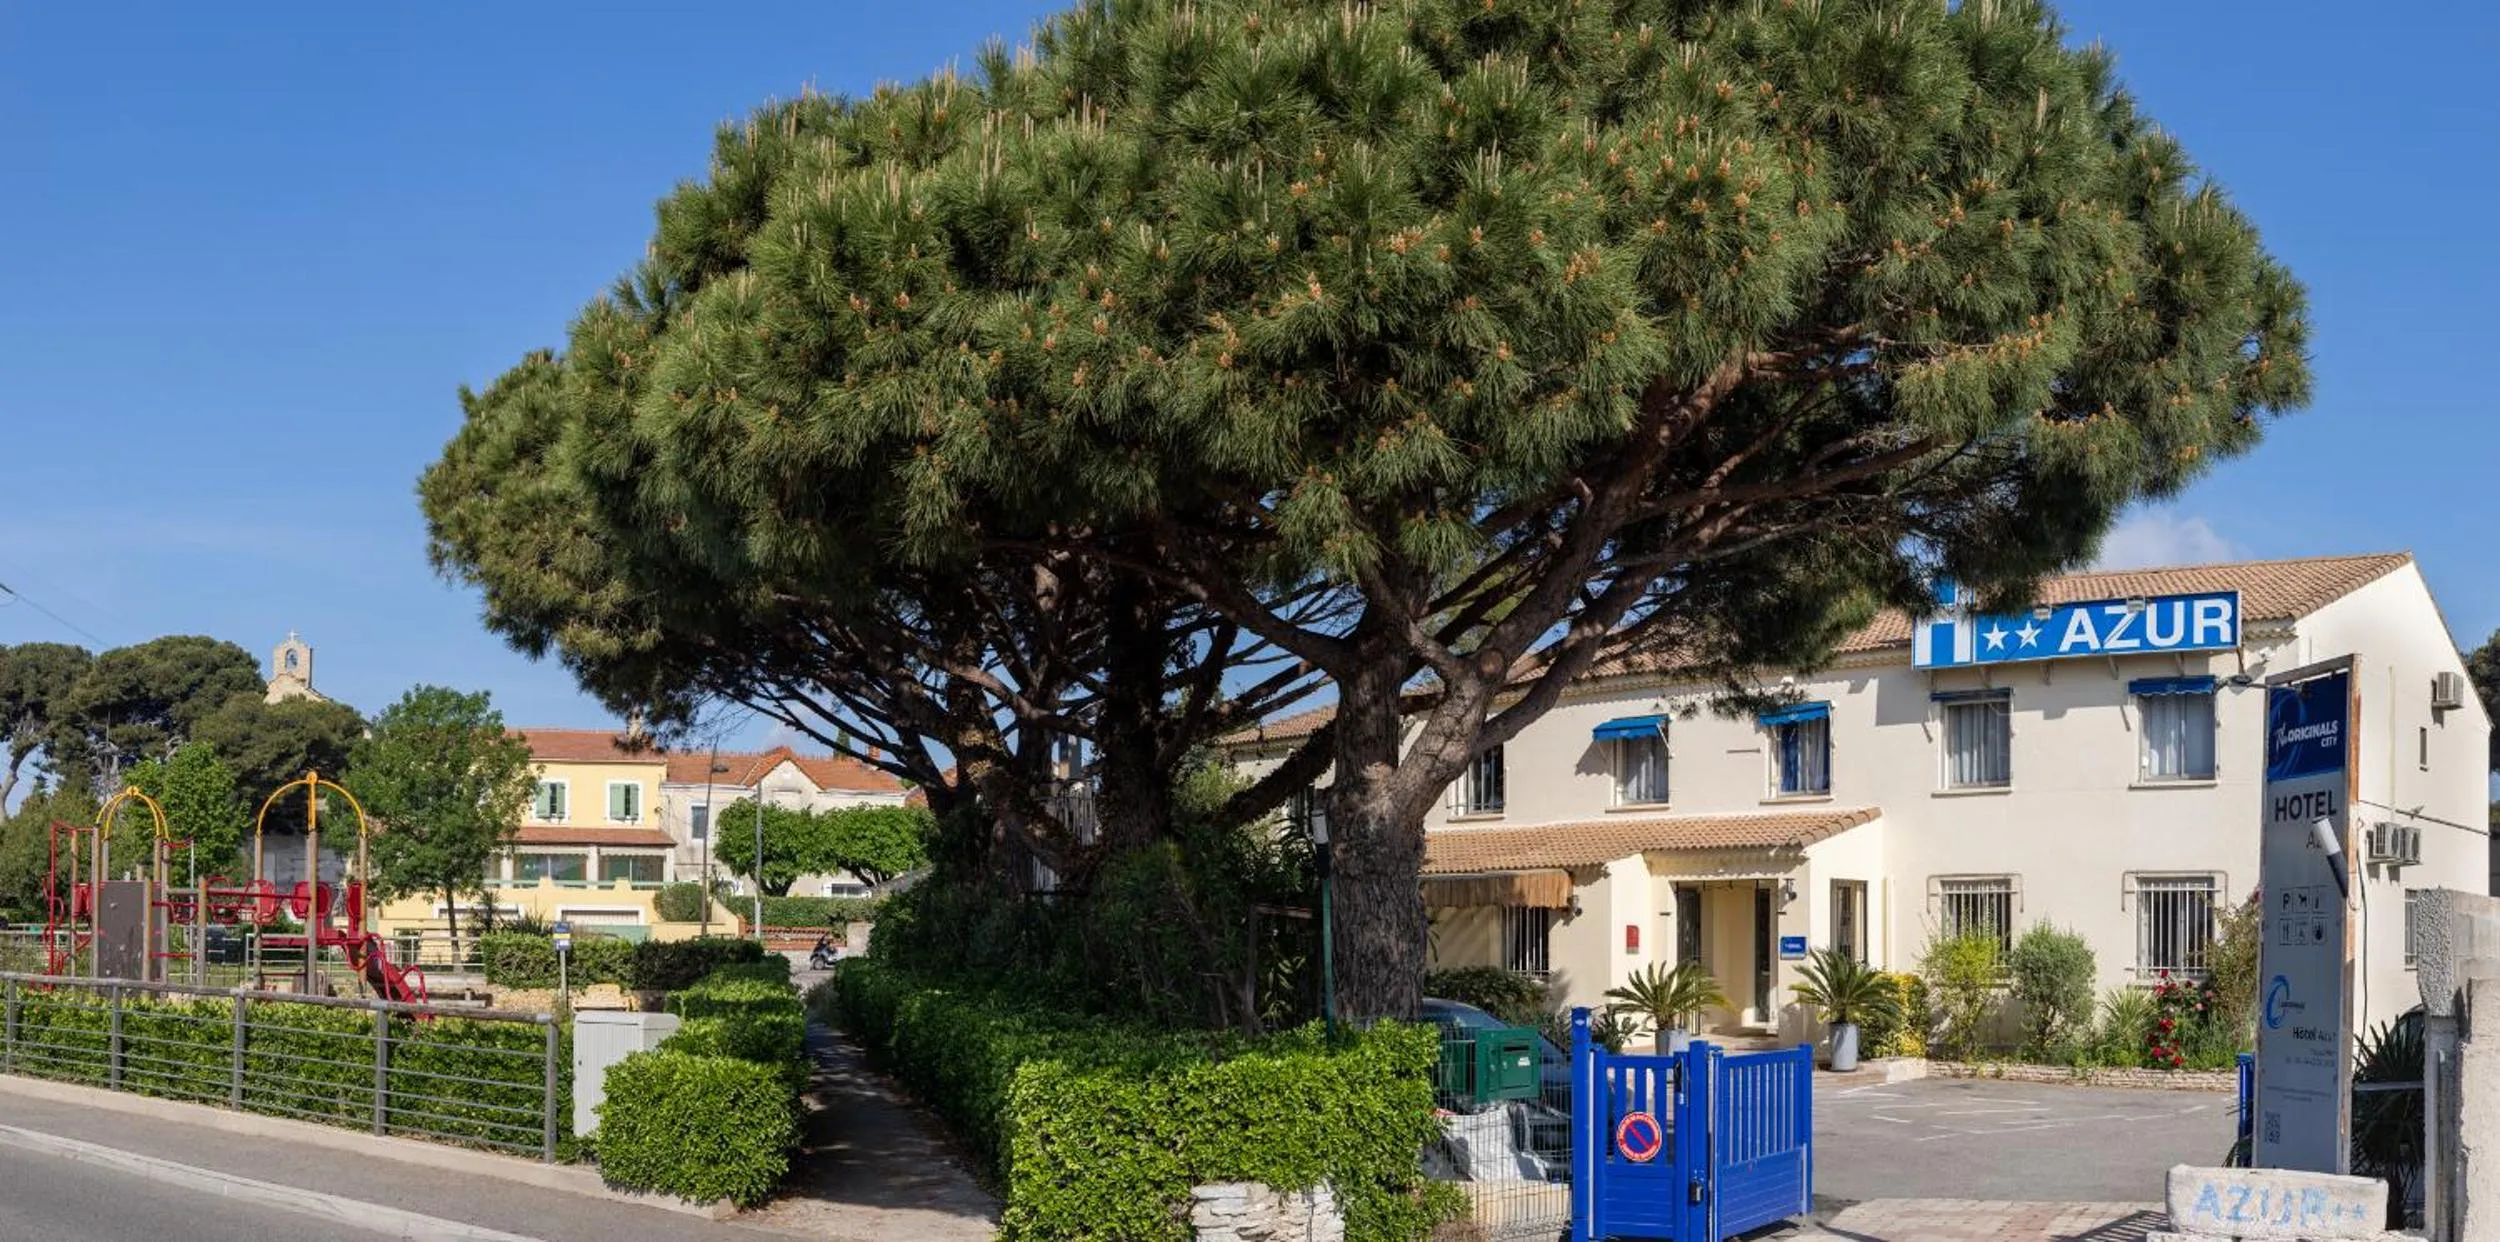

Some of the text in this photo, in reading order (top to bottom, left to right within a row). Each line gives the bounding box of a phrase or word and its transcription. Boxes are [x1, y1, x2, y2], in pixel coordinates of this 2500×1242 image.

[2059, 598, 2232, 652] AZUR
[2287, 720, 2339, 742] ORIGINALS
[2321, 736, 2338, 748] CITY
[2274, 790, 2337, 822] HOTEL
[2192, 1182, 2329, 1229] AZUR
